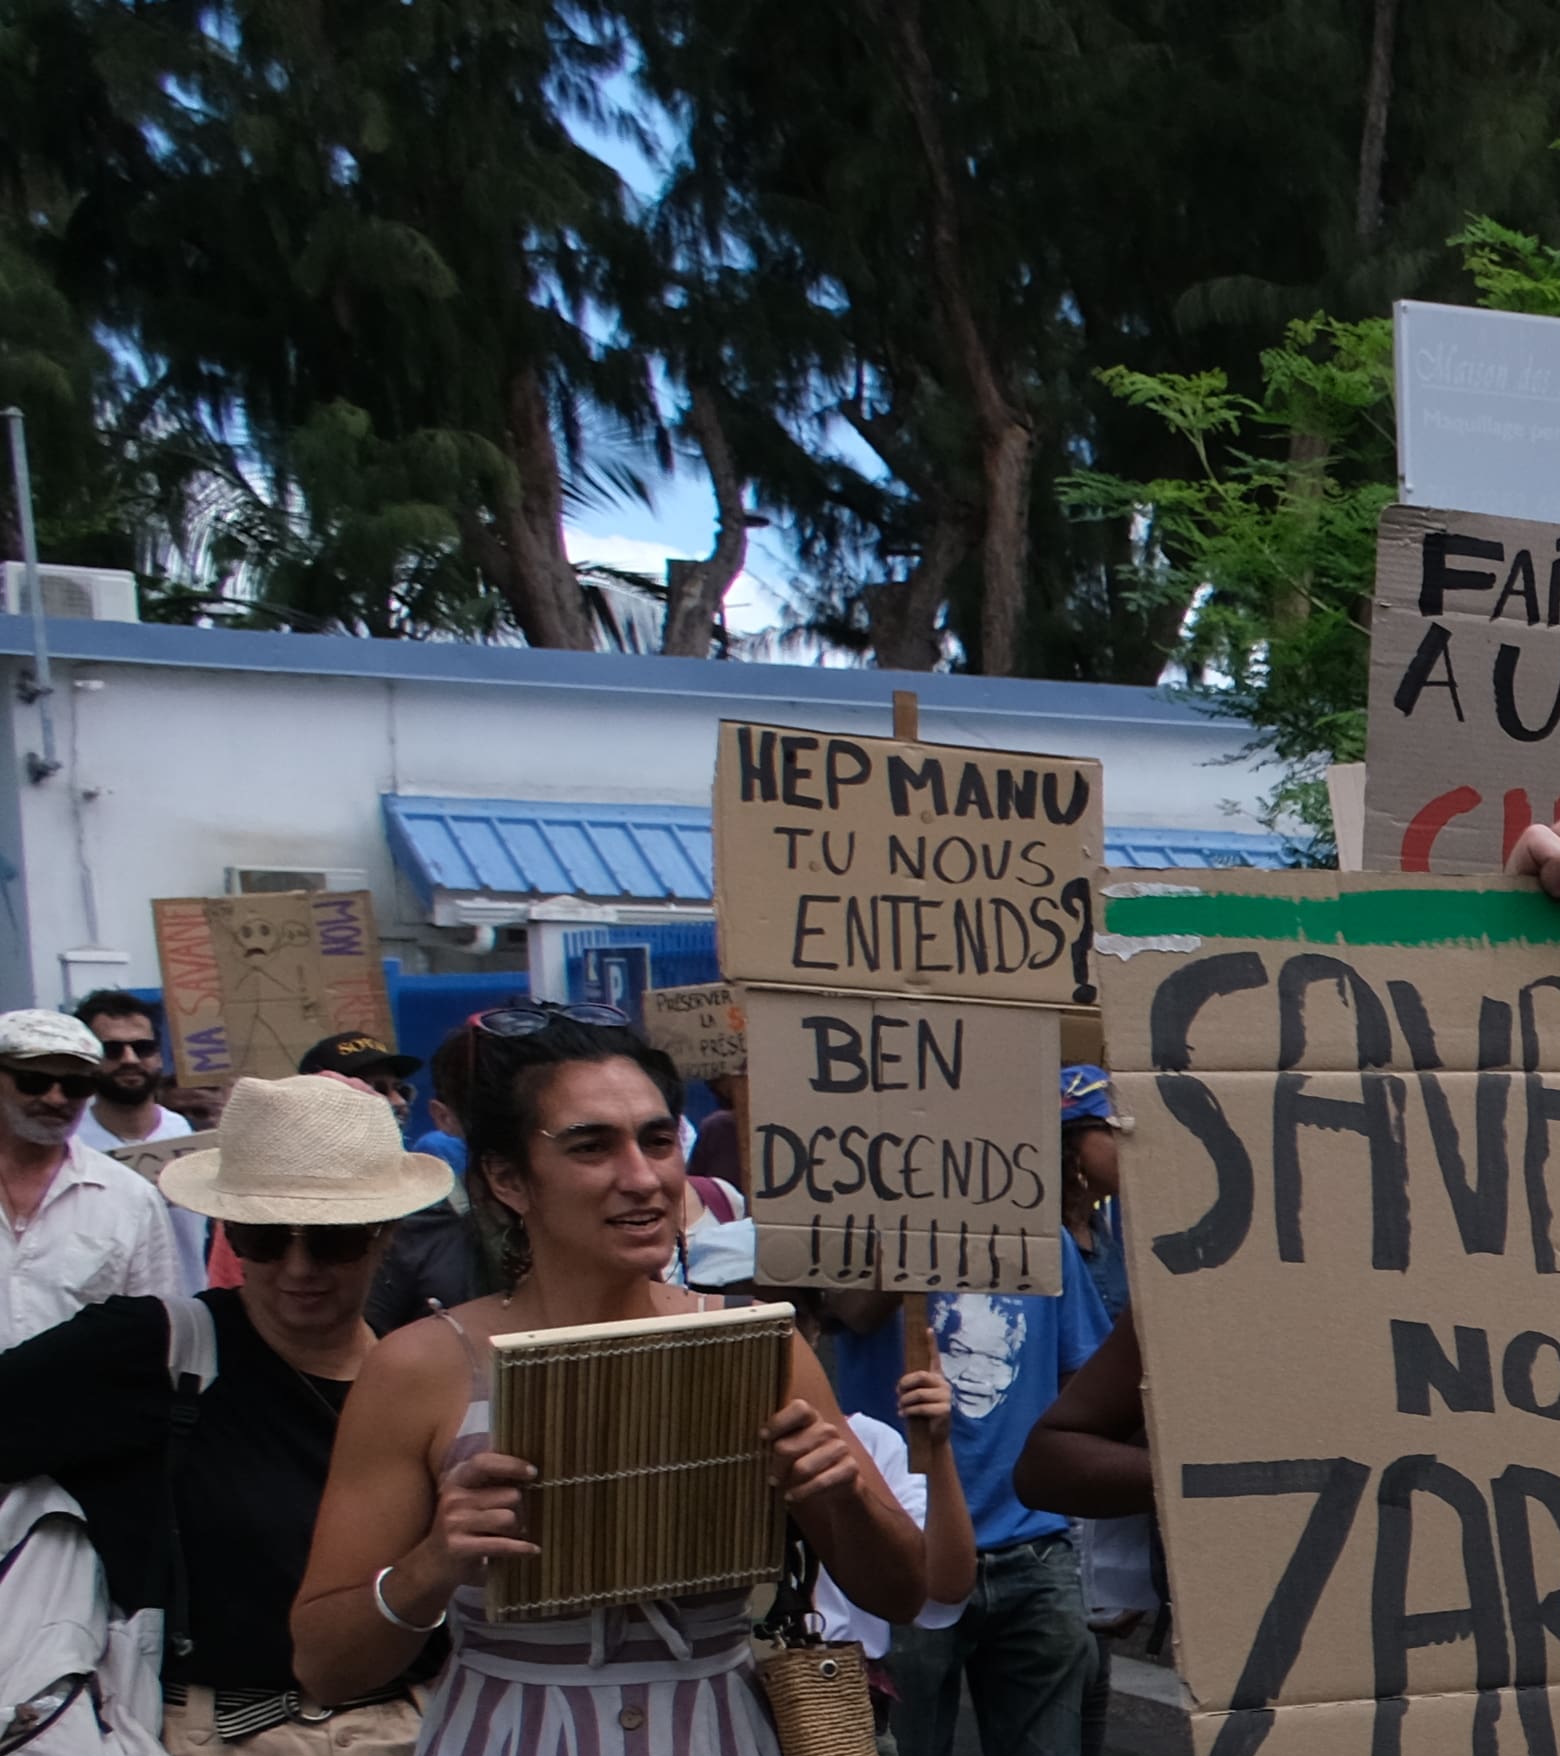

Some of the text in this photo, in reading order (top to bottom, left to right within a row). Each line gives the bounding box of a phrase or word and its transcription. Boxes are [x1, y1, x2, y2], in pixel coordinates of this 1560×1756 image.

[1415, 340, 1510, 391] Maison
[1517, 352, 1553, 395] des
[1422, 407, 1525, 442] Maquillage
[738, 726, 1091, 826] HEP MANU
[773, 826, 1056, 888] TU NOUS
[312, 899, 367, 957] MON
[180, 1026, 231, 1072] MA
[801, 1014, 965, 1093] BEN
[755, 1123, 1046, 1210] DESCENDS
